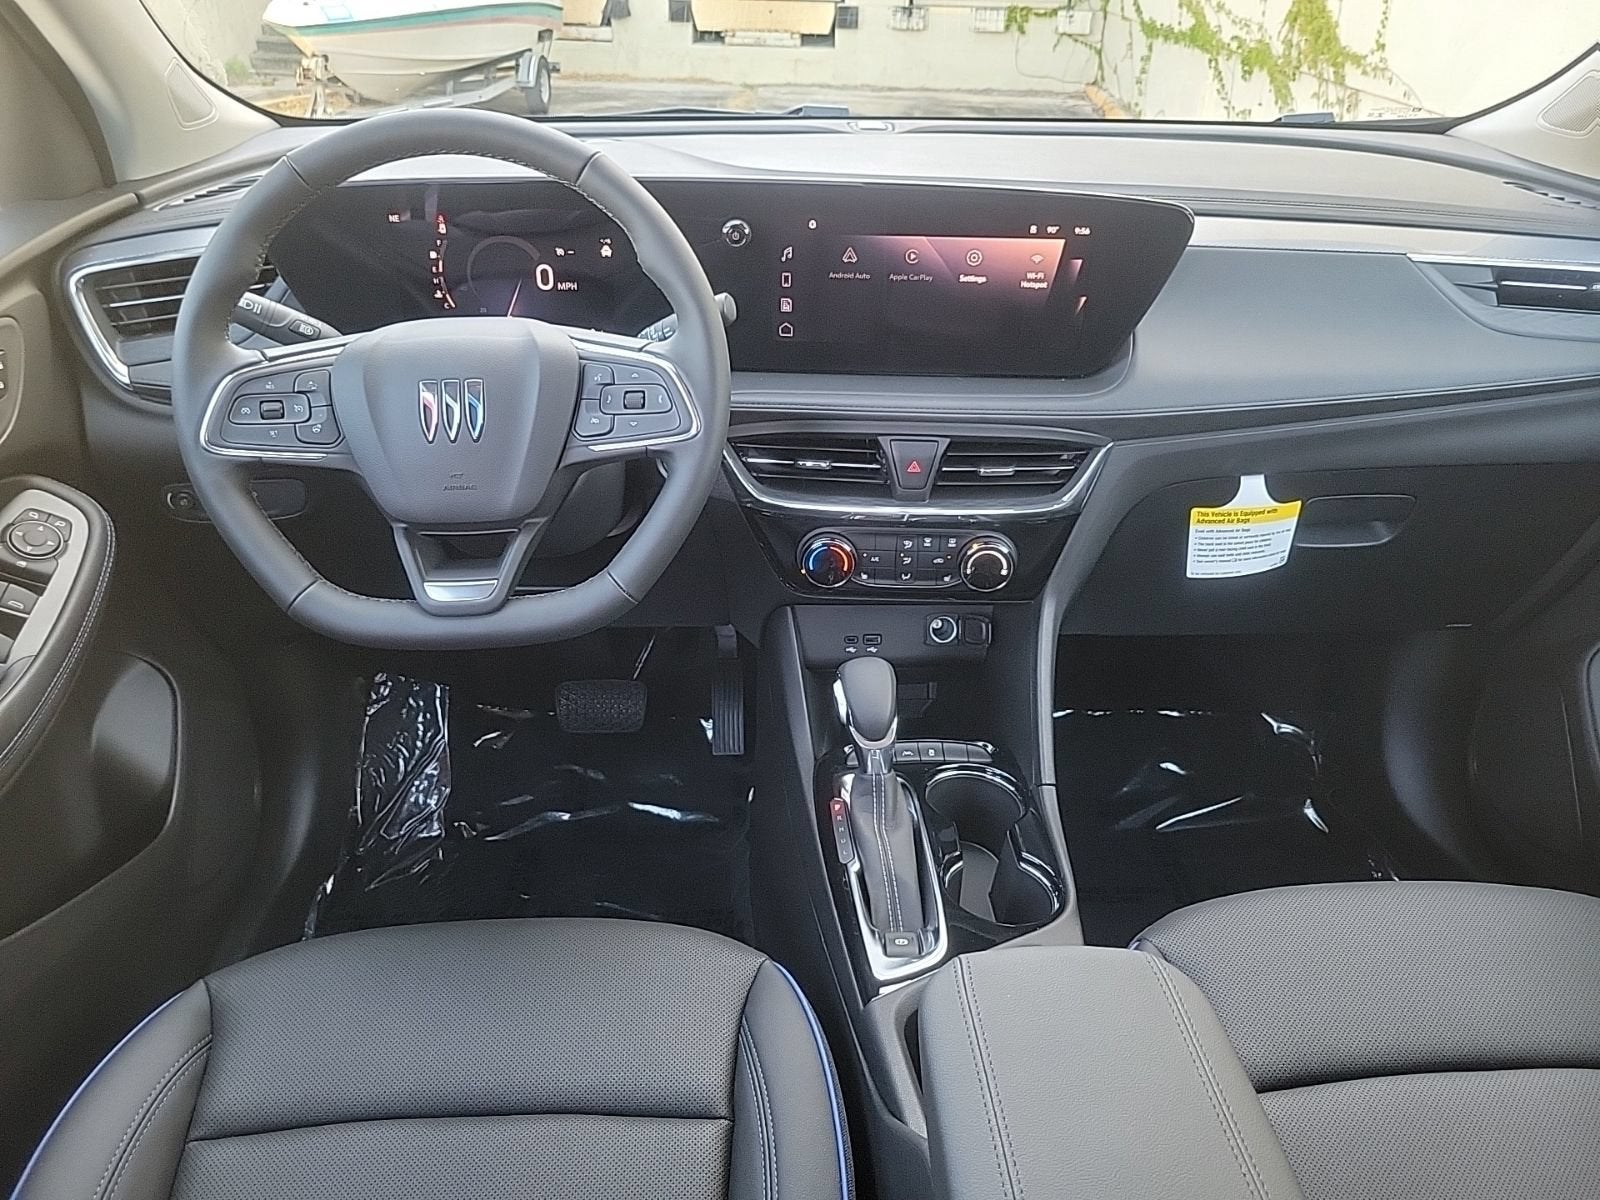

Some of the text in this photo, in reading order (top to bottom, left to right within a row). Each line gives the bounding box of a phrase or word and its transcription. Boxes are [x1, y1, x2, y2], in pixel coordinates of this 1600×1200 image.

[388, 214, 400, 223] NE
[535, 263, 578, 291] 0 MPH
[828, 271, 871, 280] Android Auto
[888, 273, 933, 283] Apple CarPlay
[959, 274, 988, 284] Settings
[1020, 280, 1049, 290] Hotspot
[1211, 510, 1232, 518] Vehicle
[1239, 509, 1266, 518] Equipped
[1236, 517, 1250, 525] Bags
